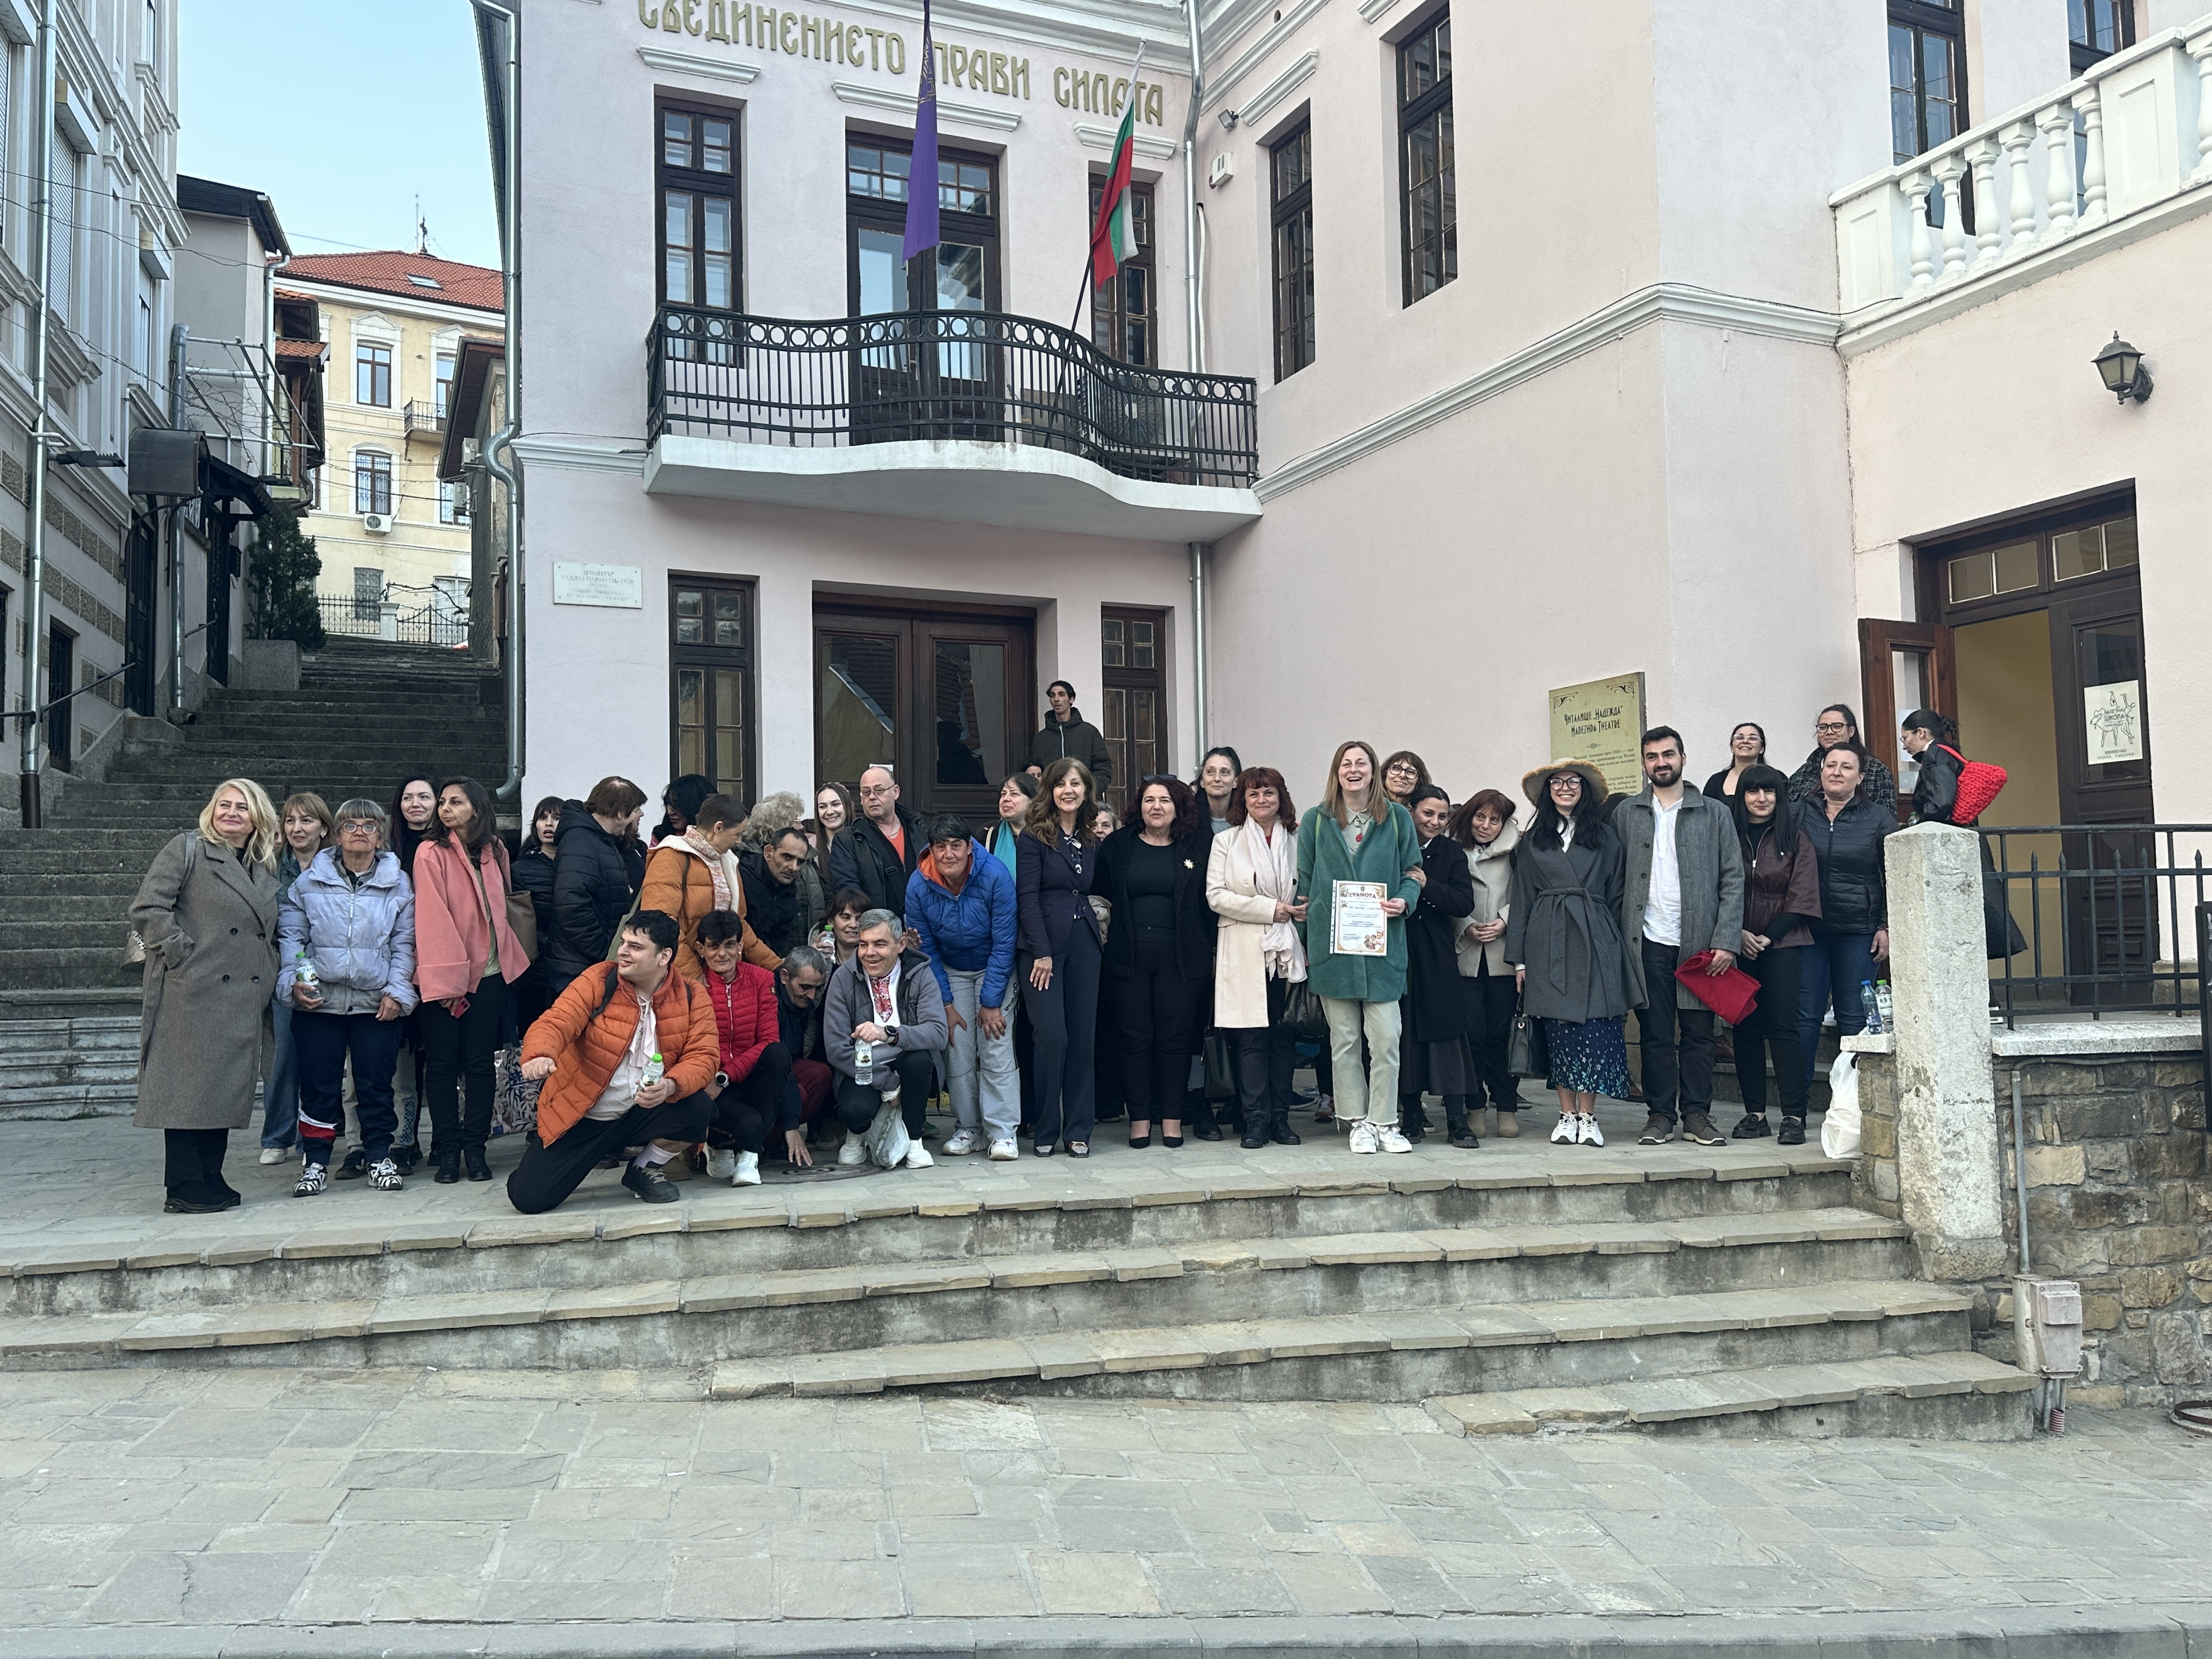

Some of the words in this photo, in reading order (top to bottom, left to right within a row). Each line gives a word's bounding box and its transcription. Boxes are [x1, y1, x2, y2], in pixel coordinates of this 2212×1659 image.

[932, 41, 1029, 99] ПРАВИ
[1053, 66, 1163, 126] СИЛАТА
[1571, 724, 1596, 737] NADEZHDA
[1598, 719, 1621, 733] THEATRE
